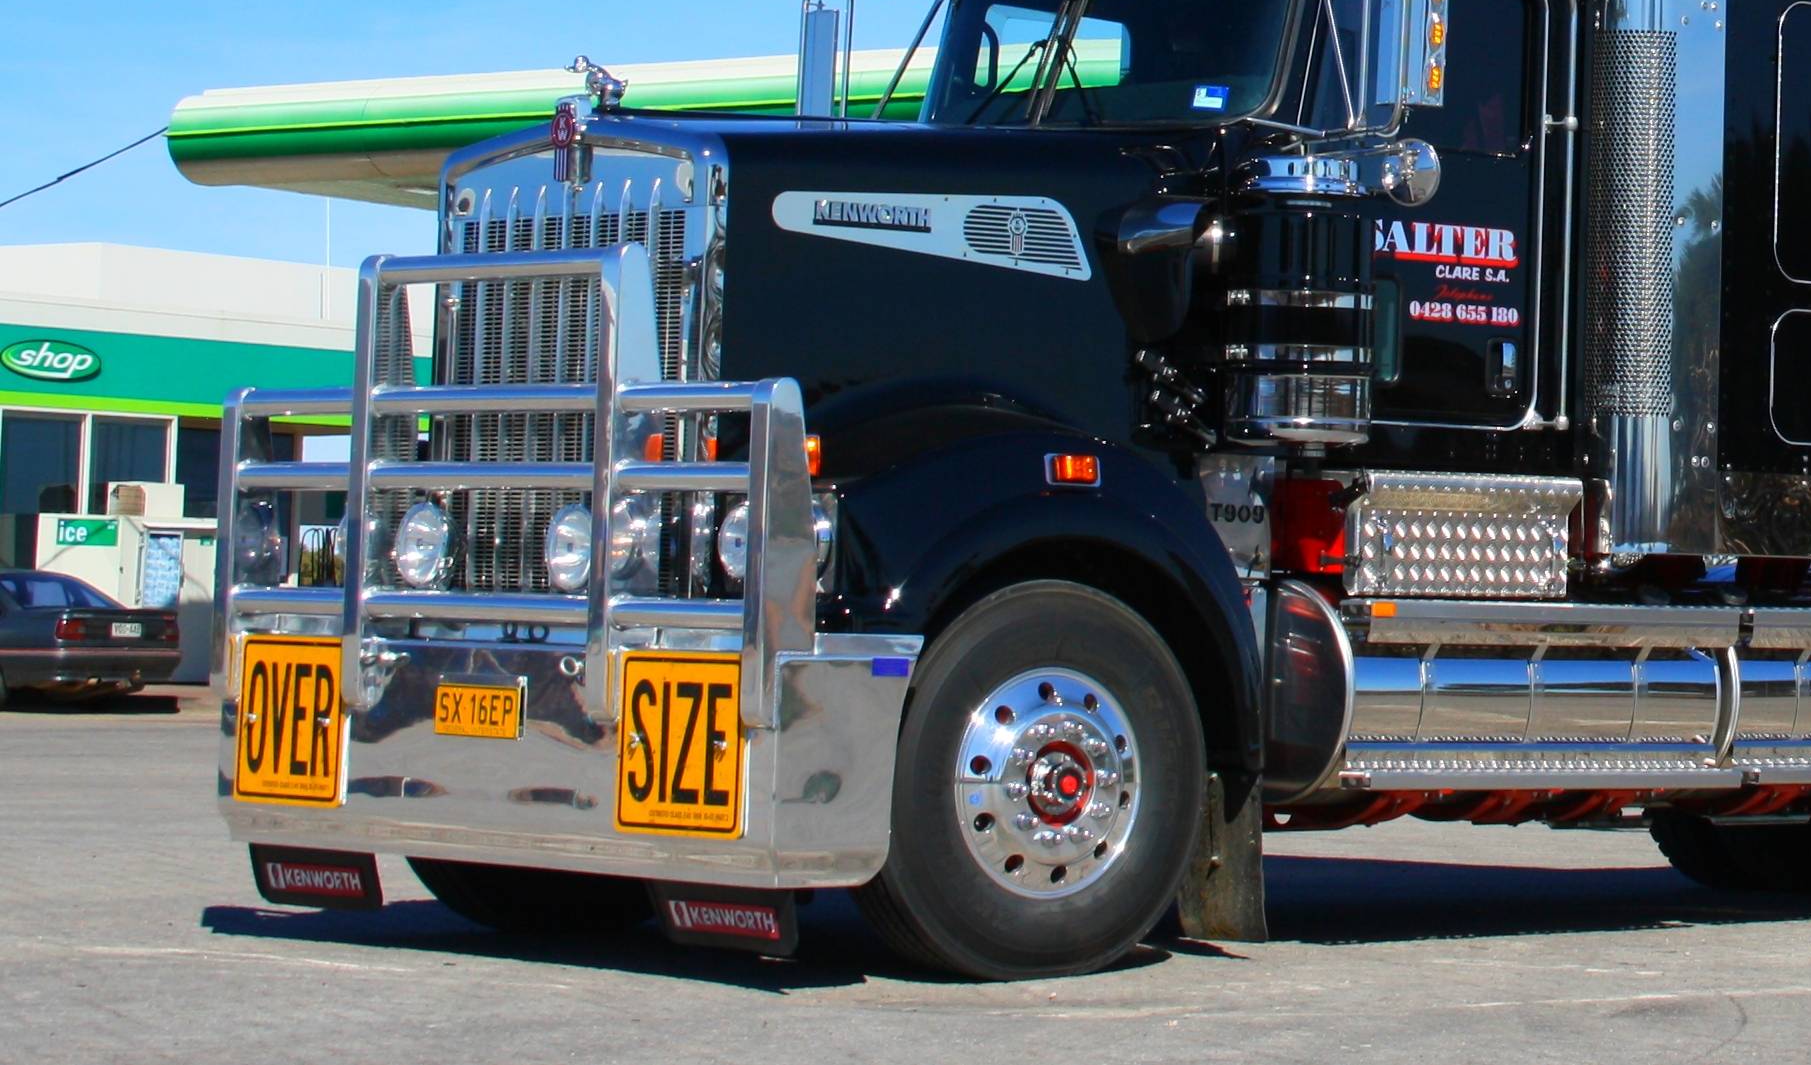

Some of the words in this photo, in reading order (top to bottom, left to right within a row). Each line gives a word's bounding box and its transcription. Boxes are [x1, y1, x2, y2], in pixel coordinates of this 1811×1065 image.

[814, 199, 932, 230] KENWORTH
[1435, 264, 1481, 281] CLARE
[1485, 267, 1510, 283] S.A.
[1409, 300, 1453, 319] 0428
[1456, 303, 1487, 322] 655
[1491, 306, 1519, 324] 180
[19, 342, 93, 378] shop
[1210, 503, 1264, 524] T909
[58, 520, 88, 543] ice
[246, 659, 336, 778] OVER
[627, 678, 733, 807] SIZE
[284, 867, 362, 891] KENWORTH
[690, 906, 776, 931] KENWORTH
